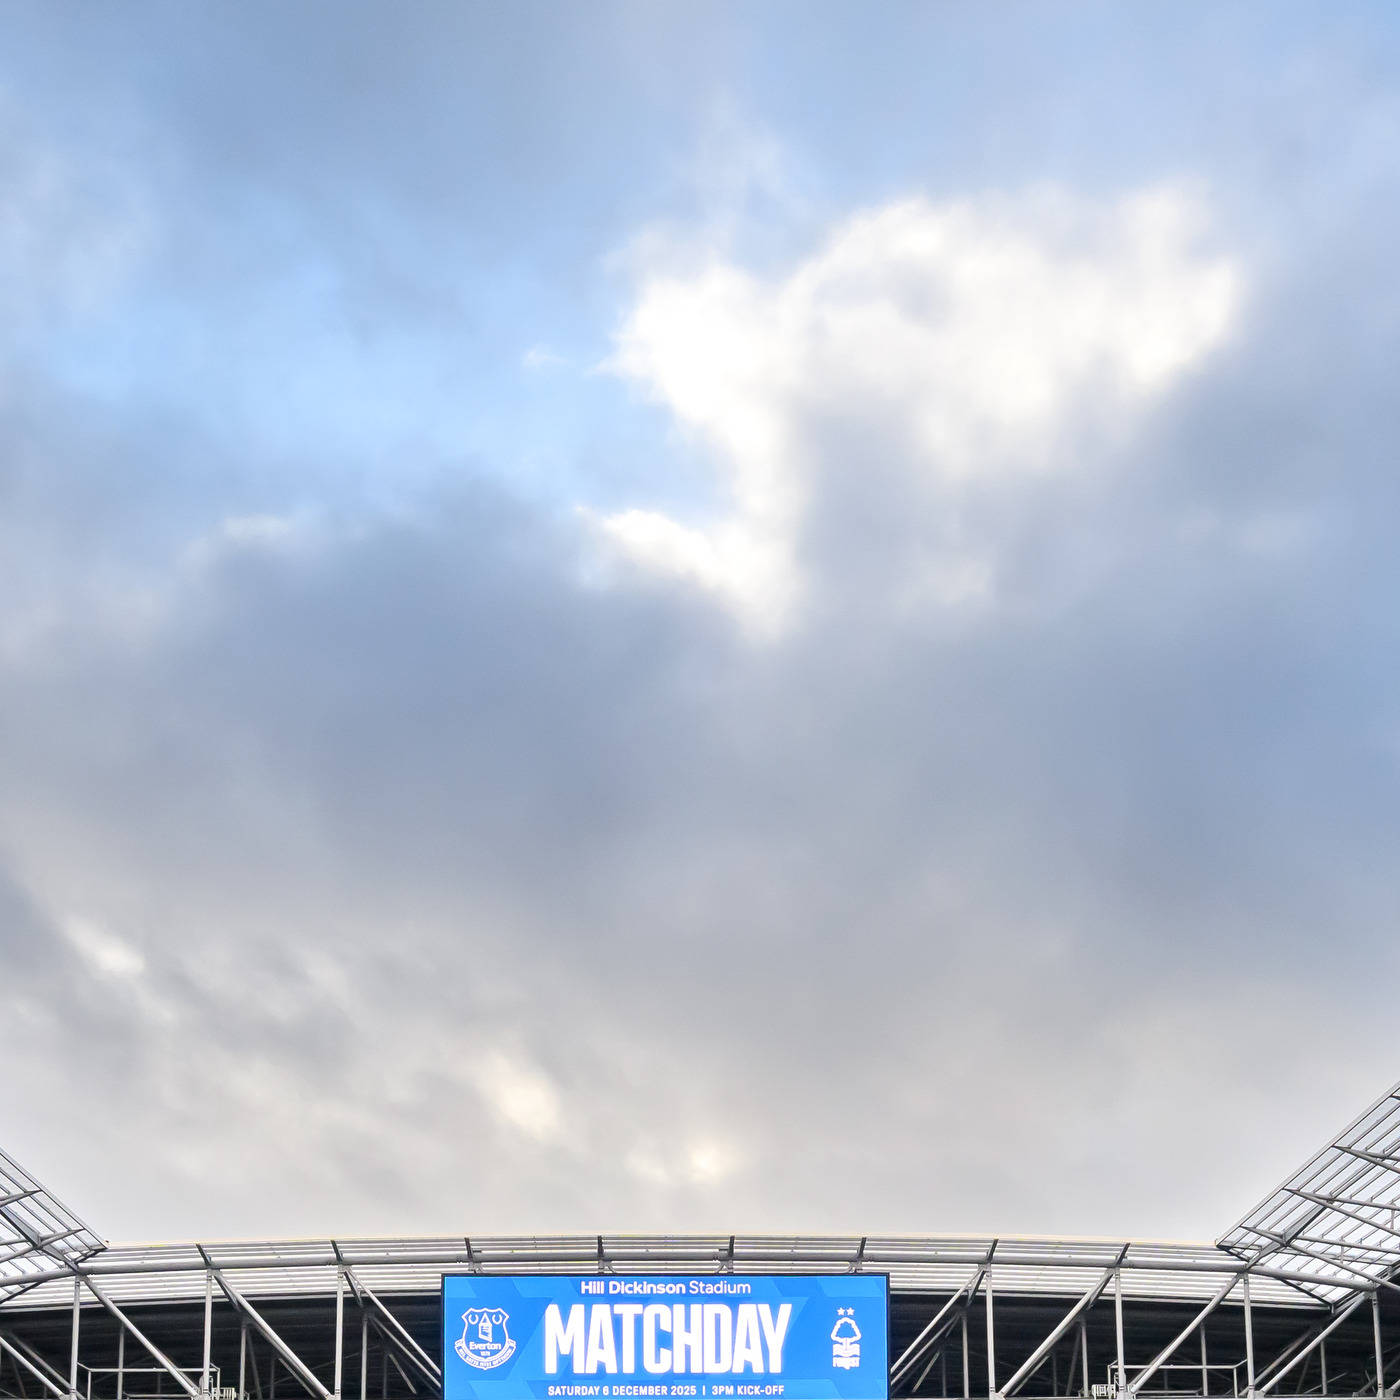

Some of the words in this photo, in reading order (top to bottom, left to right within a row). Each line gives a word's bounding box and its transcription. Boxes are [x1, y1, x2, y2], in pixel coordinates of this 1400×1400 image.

[581, 1281, 605, 1294] Hill
[608, 1281, 687, 1294] Dickinson
[689, 1281, 751, 1294] Stadium
[544, 1303, 793, 1374] MATCHDAY
[469, 1341, 502, 1350] Everton
[547, 1385, 600, 1396] SATURDAY
[602, 1385, 610, 1396] 6
[612, 1385, 668, 1396] DECEMBER
[670, 1385, 697, 1396] 2025
[711, 1385, 734, 1396] 3PM
[737, 1385, 785, 1396] KICK-OFF
